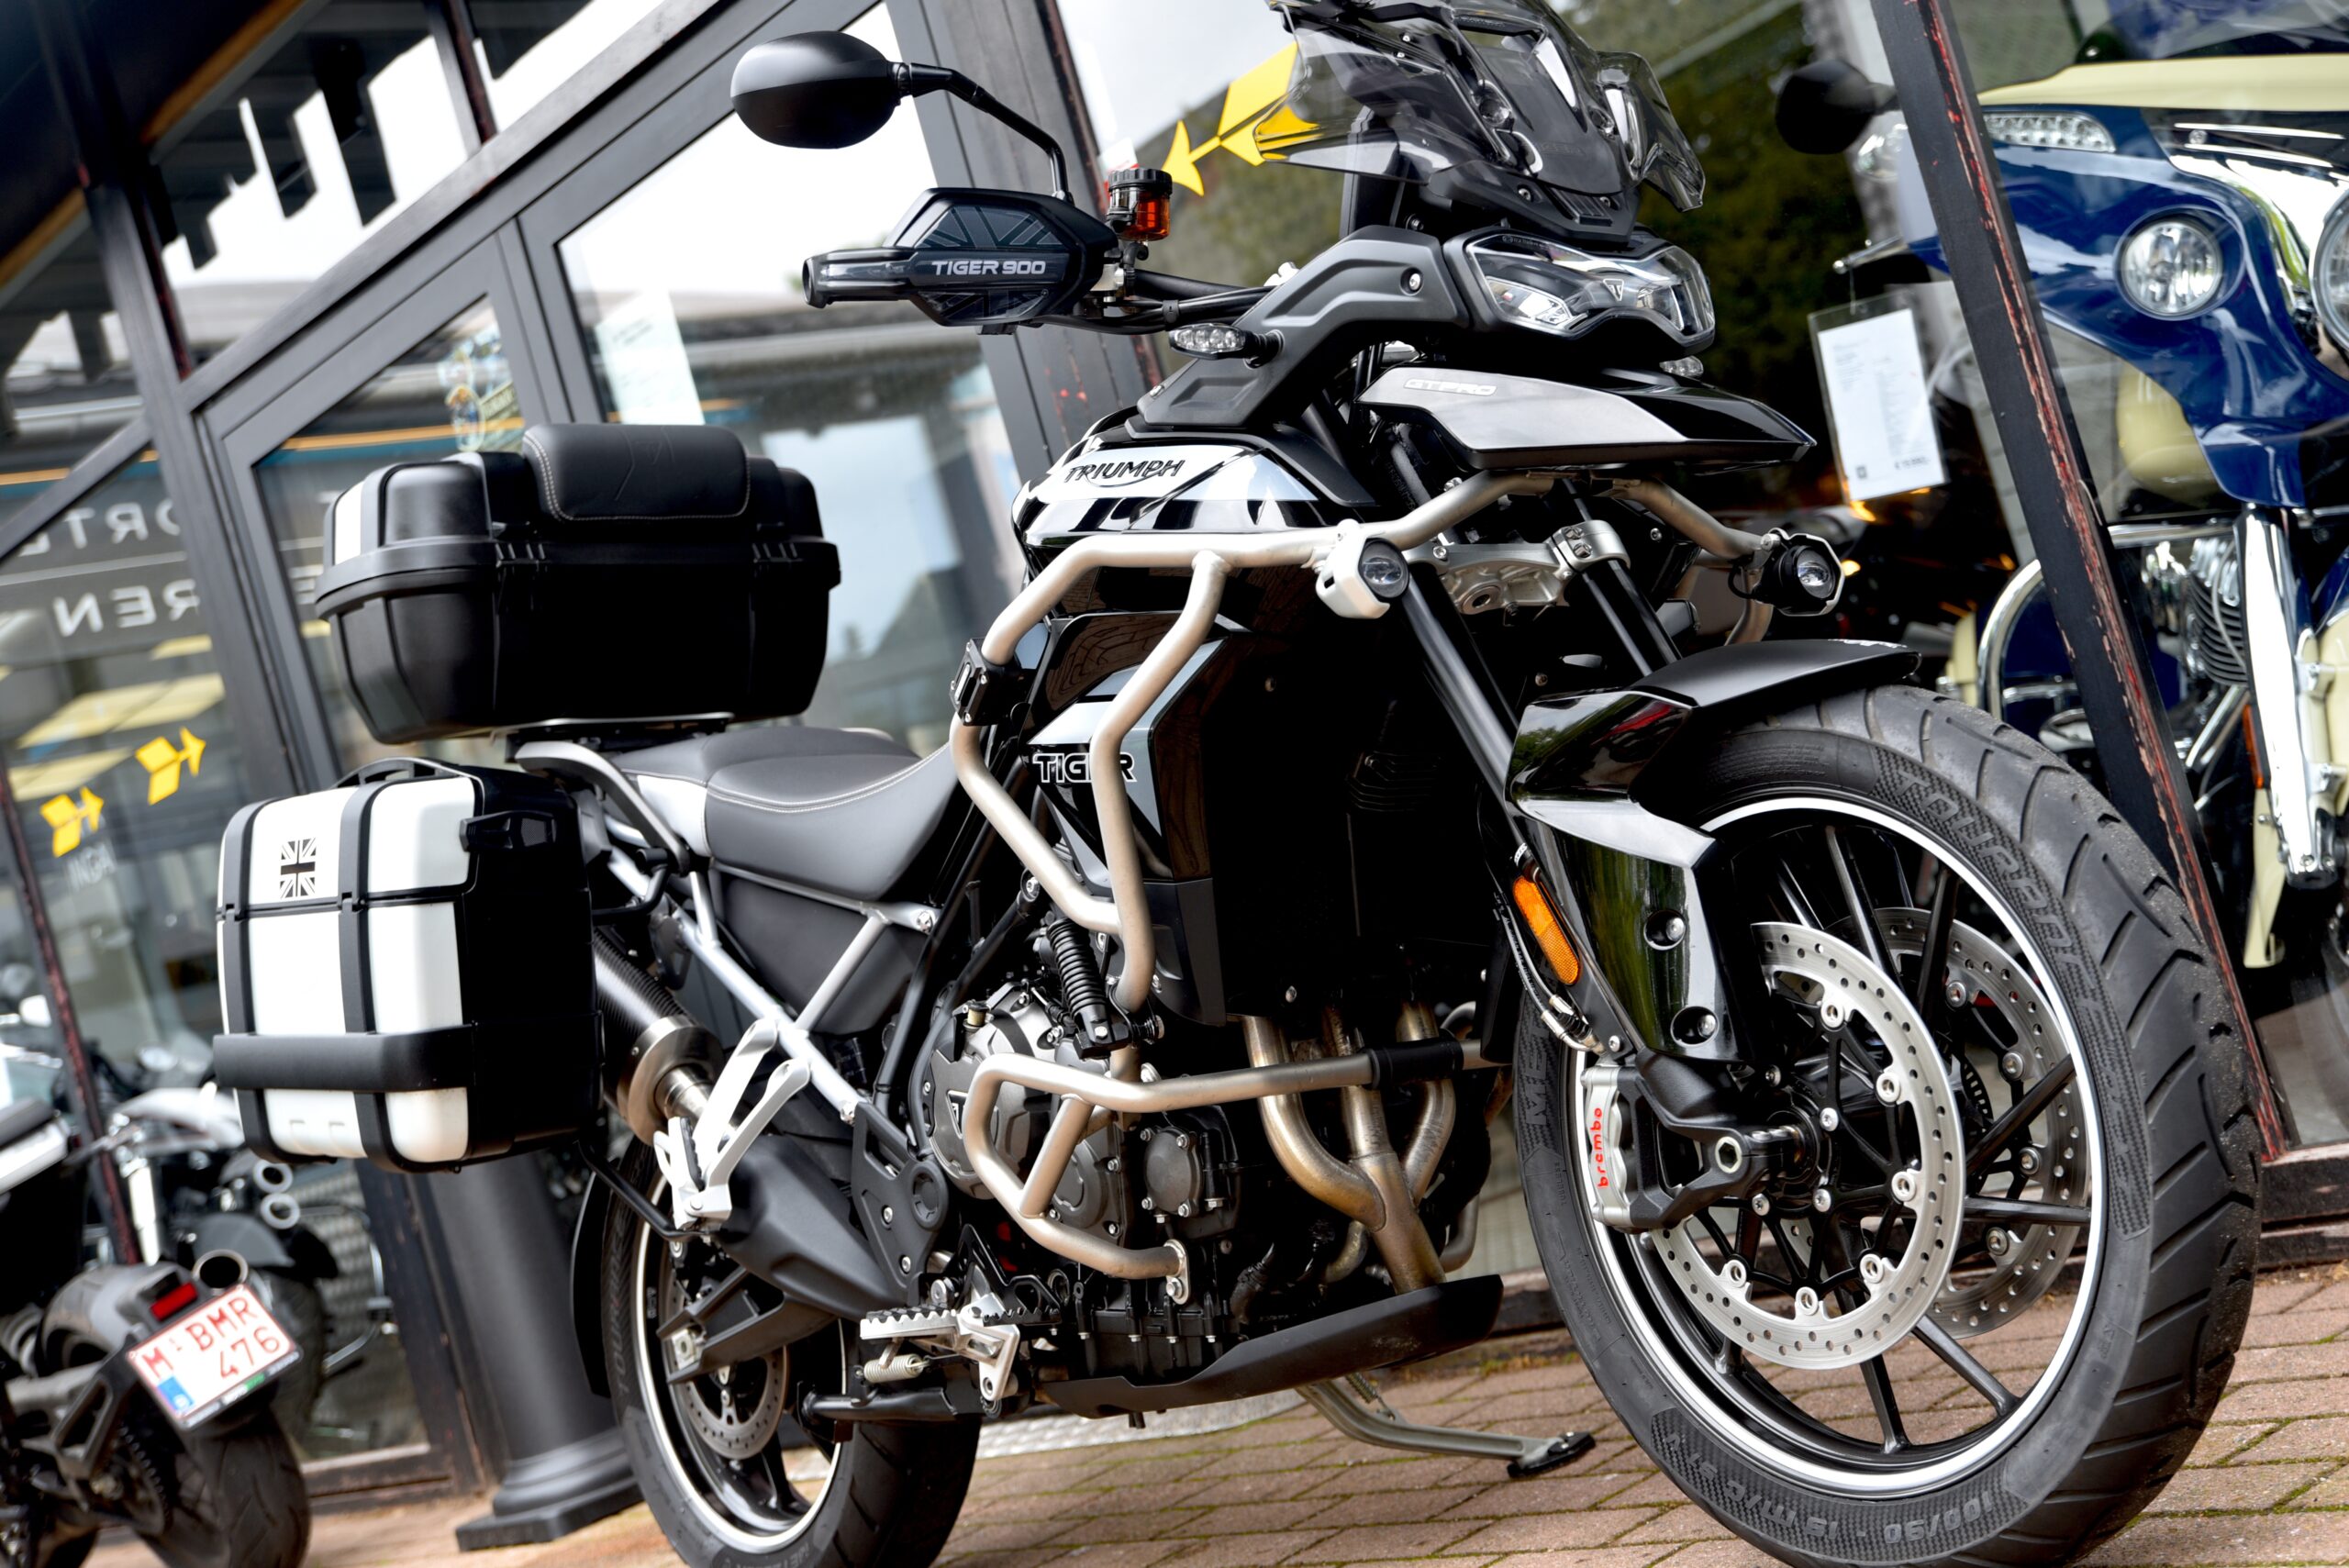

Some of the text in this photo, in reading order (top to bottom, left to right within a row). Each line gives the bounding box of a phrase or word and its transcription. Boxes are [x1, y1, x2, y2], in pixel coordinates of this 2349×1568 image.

[932, 260, 1046, 276] TIGER 900
[1064, 460, 1186, 486] TRIUMPH
[1033, 752, 1137, 784] TIGR
[1590, 1106, 1609, 1190] brembo
[219, 1327, 280, 1380] 476
[1884, 1491, 1994, 1544] 100/90
